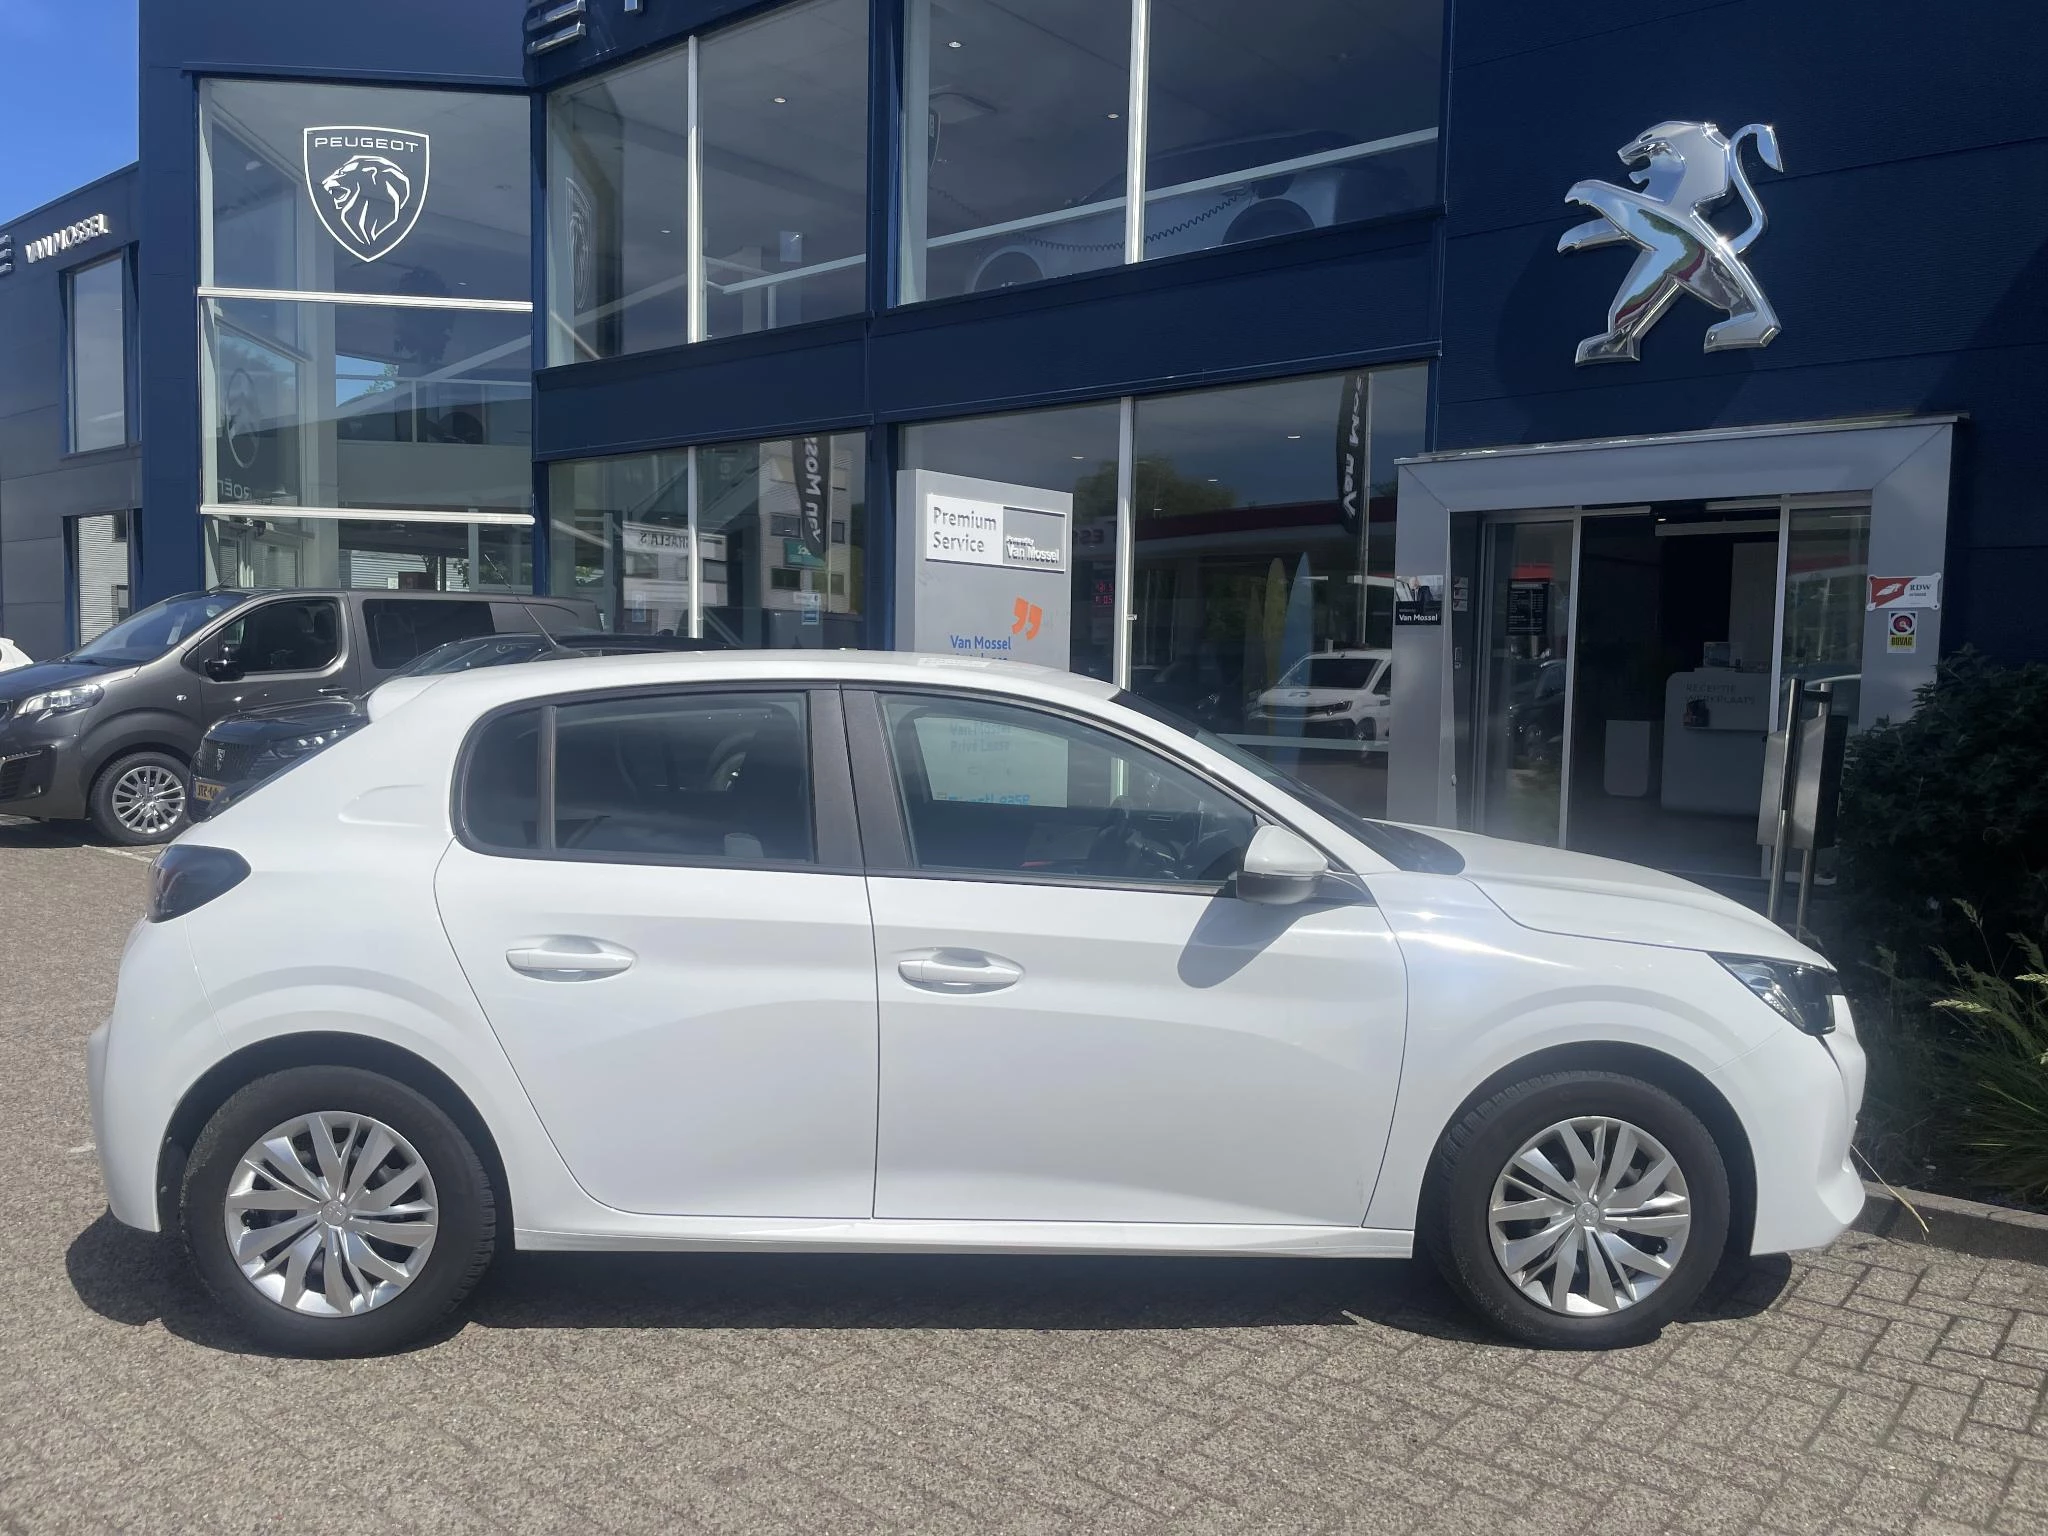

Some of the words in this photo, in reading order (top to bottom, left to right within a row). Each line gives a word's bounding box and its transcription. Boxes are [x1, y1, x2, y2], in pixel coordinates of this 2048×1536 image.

[314, 136, 419, 153] PEUGEOT
[933, 506, 997, 531] Premium
[933, 531, 985, 553] Service
[1007, 544, 1025, 559] Van
[1027, 546, 1060, 562] Mossel
[1413, 613, 1438, 621] Mossel
[950, 635, 971, 649] Van
[974, 635, 1011, 650] Mossel
